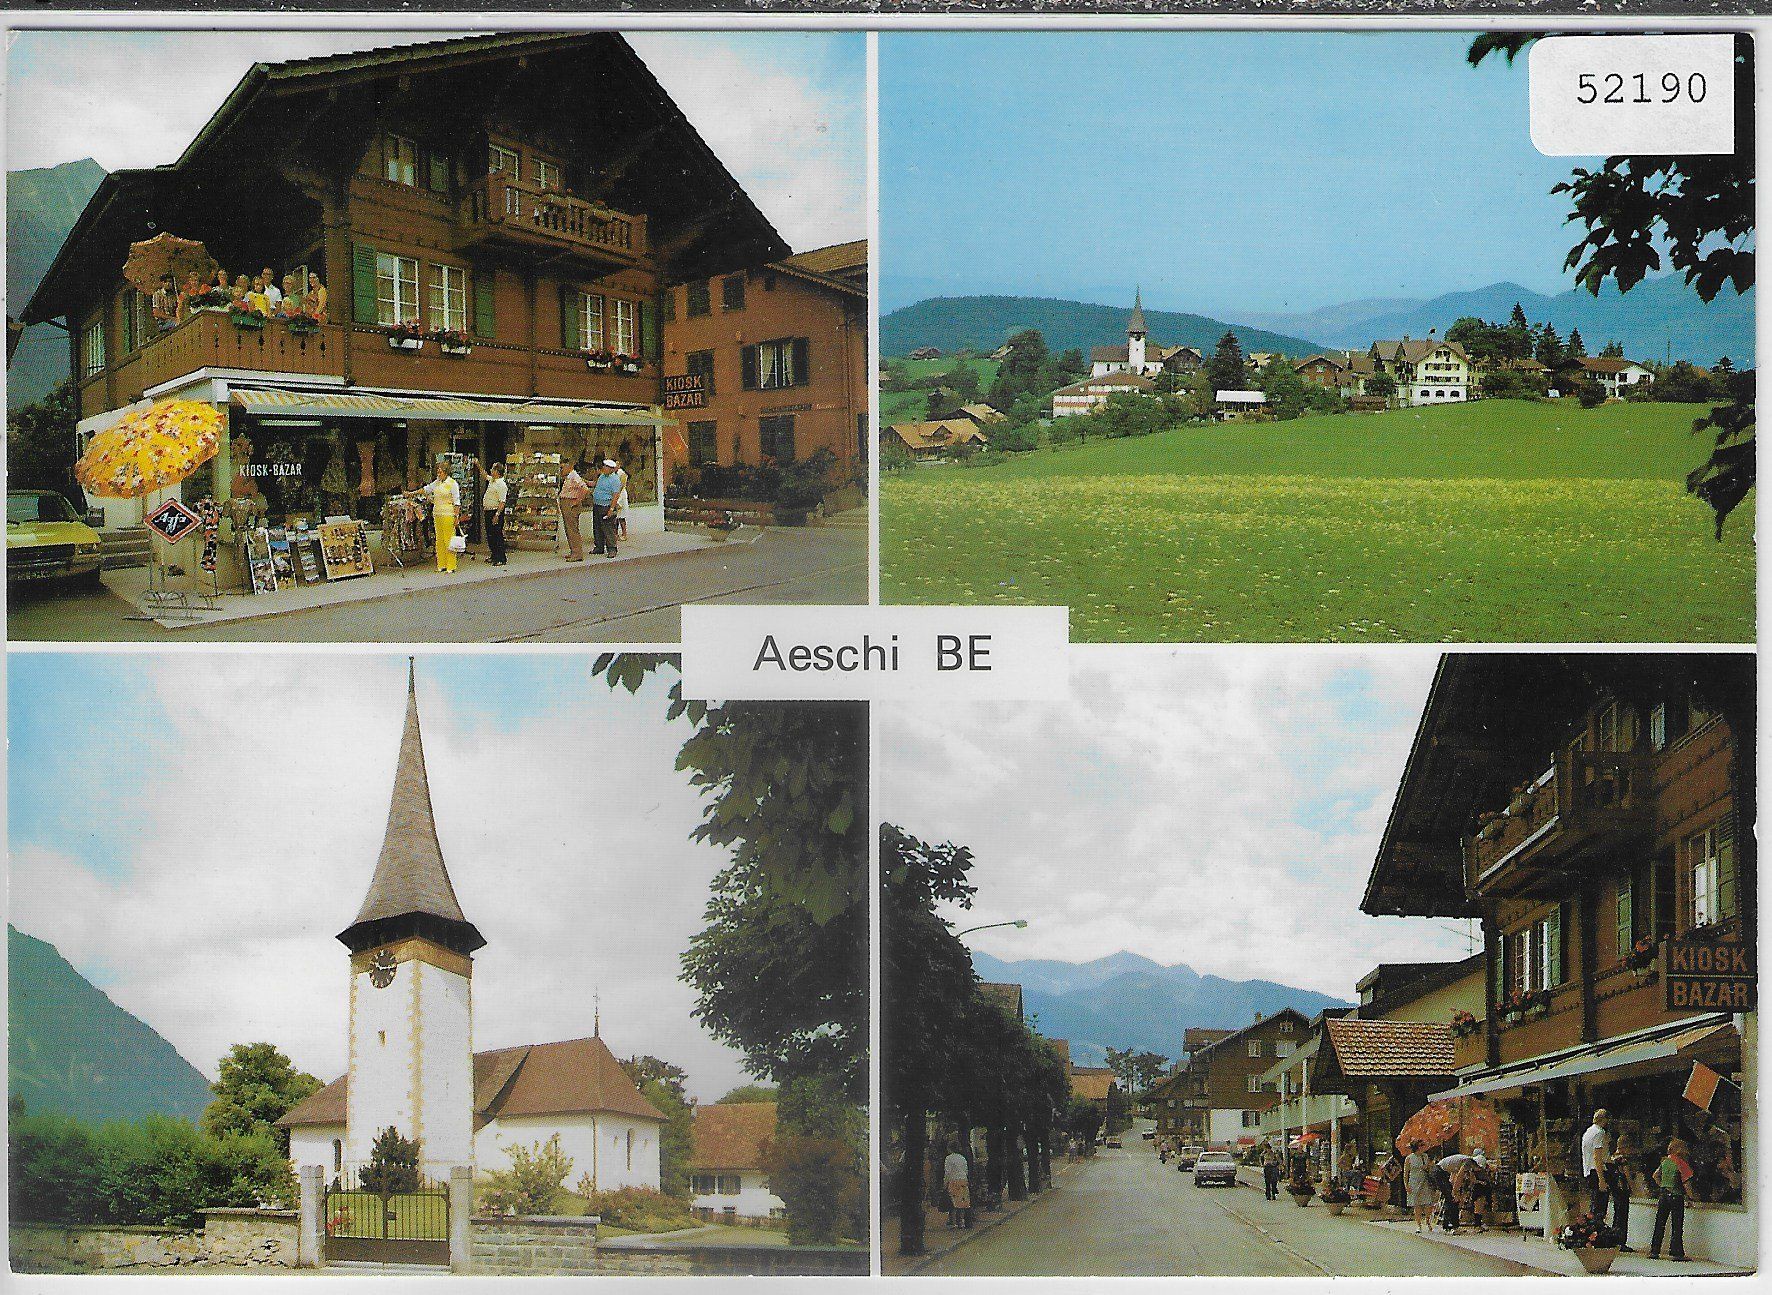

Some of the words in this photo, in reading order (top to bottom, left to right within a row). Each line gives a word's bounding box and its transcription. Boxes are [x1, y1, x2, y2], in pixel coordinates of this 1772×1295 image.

[1577, 73, 1707, 104] 52190
[666, 375, 703, 390] KIOSK
[666, 393, 703, 408] BAZAR
[154, 512, 187, 533] Agfa
[1672, 946, 1748, 973] KIOSK
[1672, 981, 1748, 1007] BAZAR
